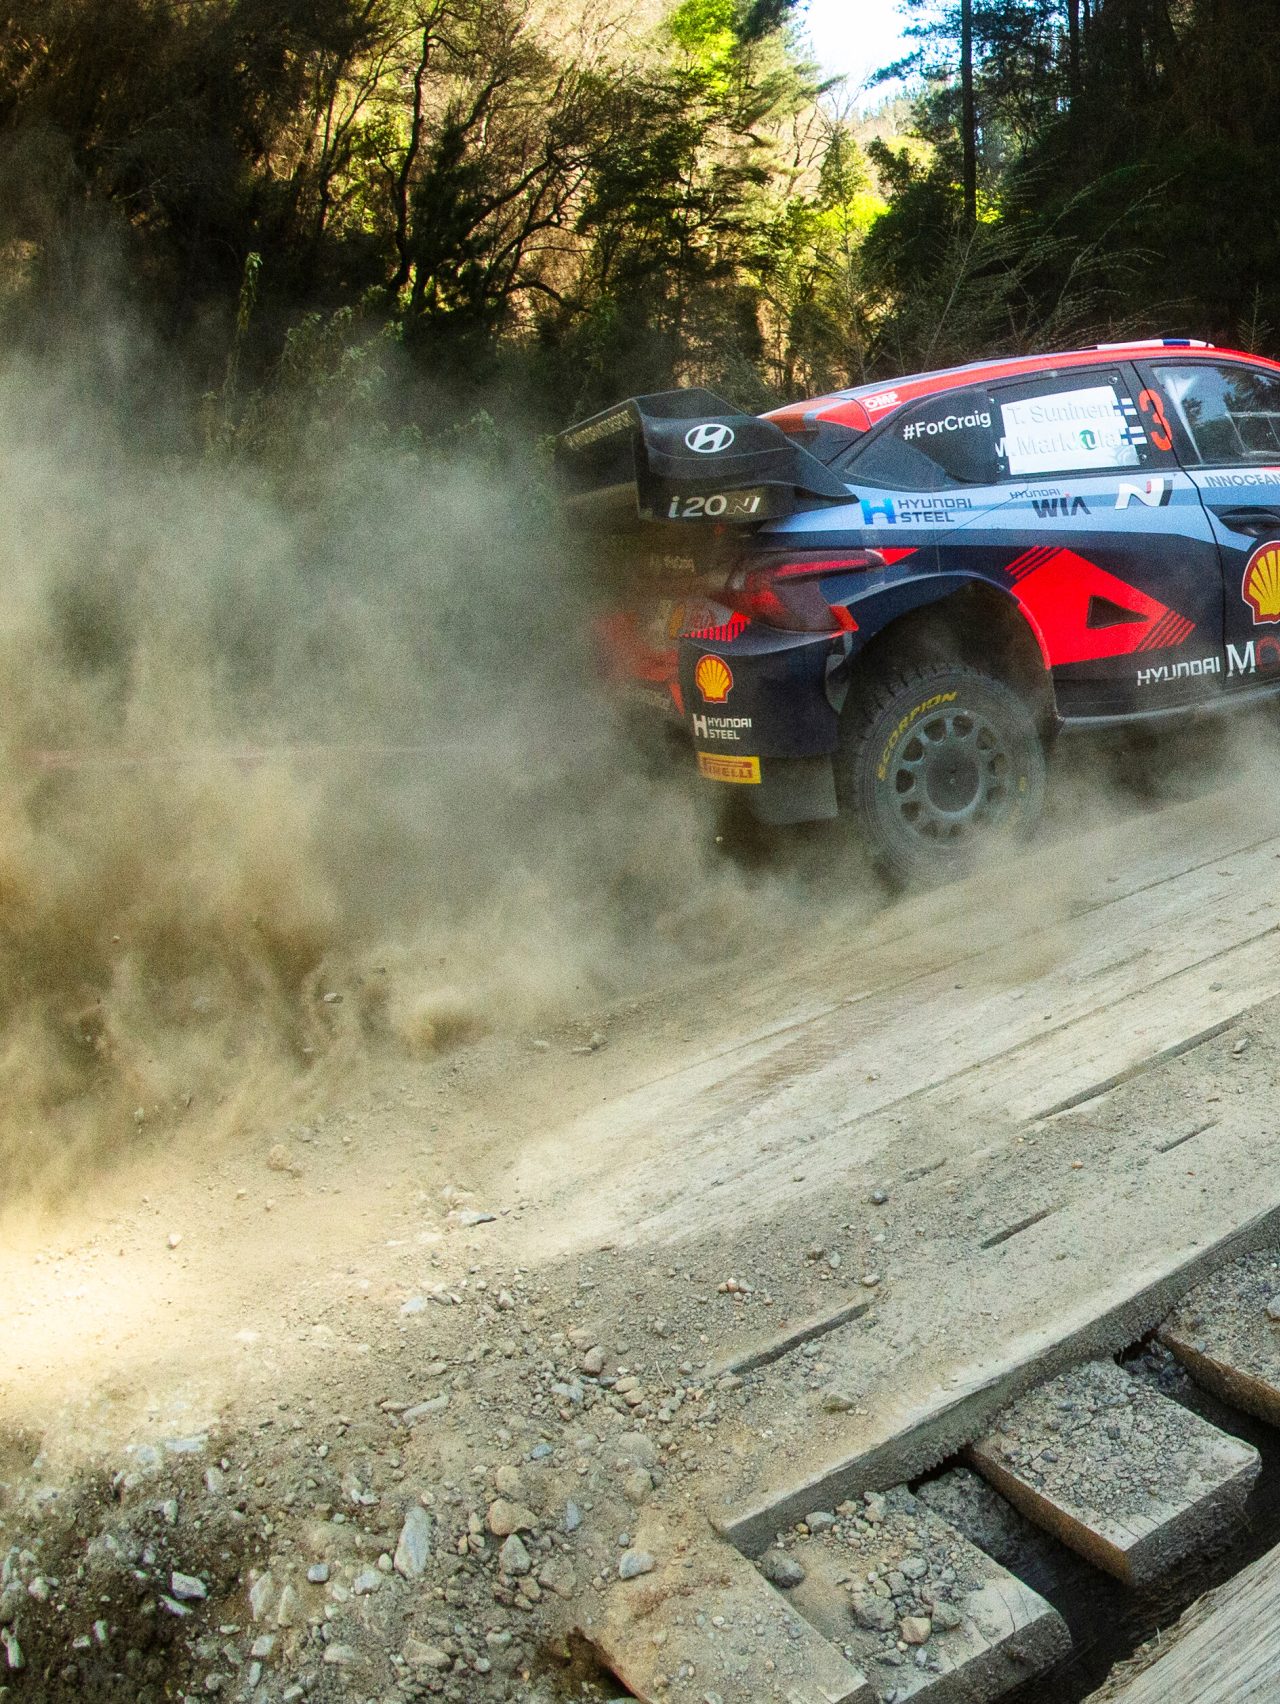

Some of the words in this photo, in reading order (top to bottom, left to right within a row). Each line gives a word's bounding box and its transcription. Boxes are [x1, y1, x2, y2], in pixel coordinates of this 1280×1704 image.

[863, 391, 899, 409] OMP
[903, 410, 992, 440] #ForCraig
[1139, 389, 1172, 451] 3
[1009, 488, 1061, 499] HYUNDAI
[668, 495, 728, 518] i20
[898, 498, 973, 509] HYUNDAI
[900, 511, 955, 523] STEEL
[1137, 656, 1221, 687] HYUNDAI
[707, 716, 753, 728] HYUNDAI
[709, 729, 741, 740] STEEL
[876, 691, 959, 781] SCORPION
